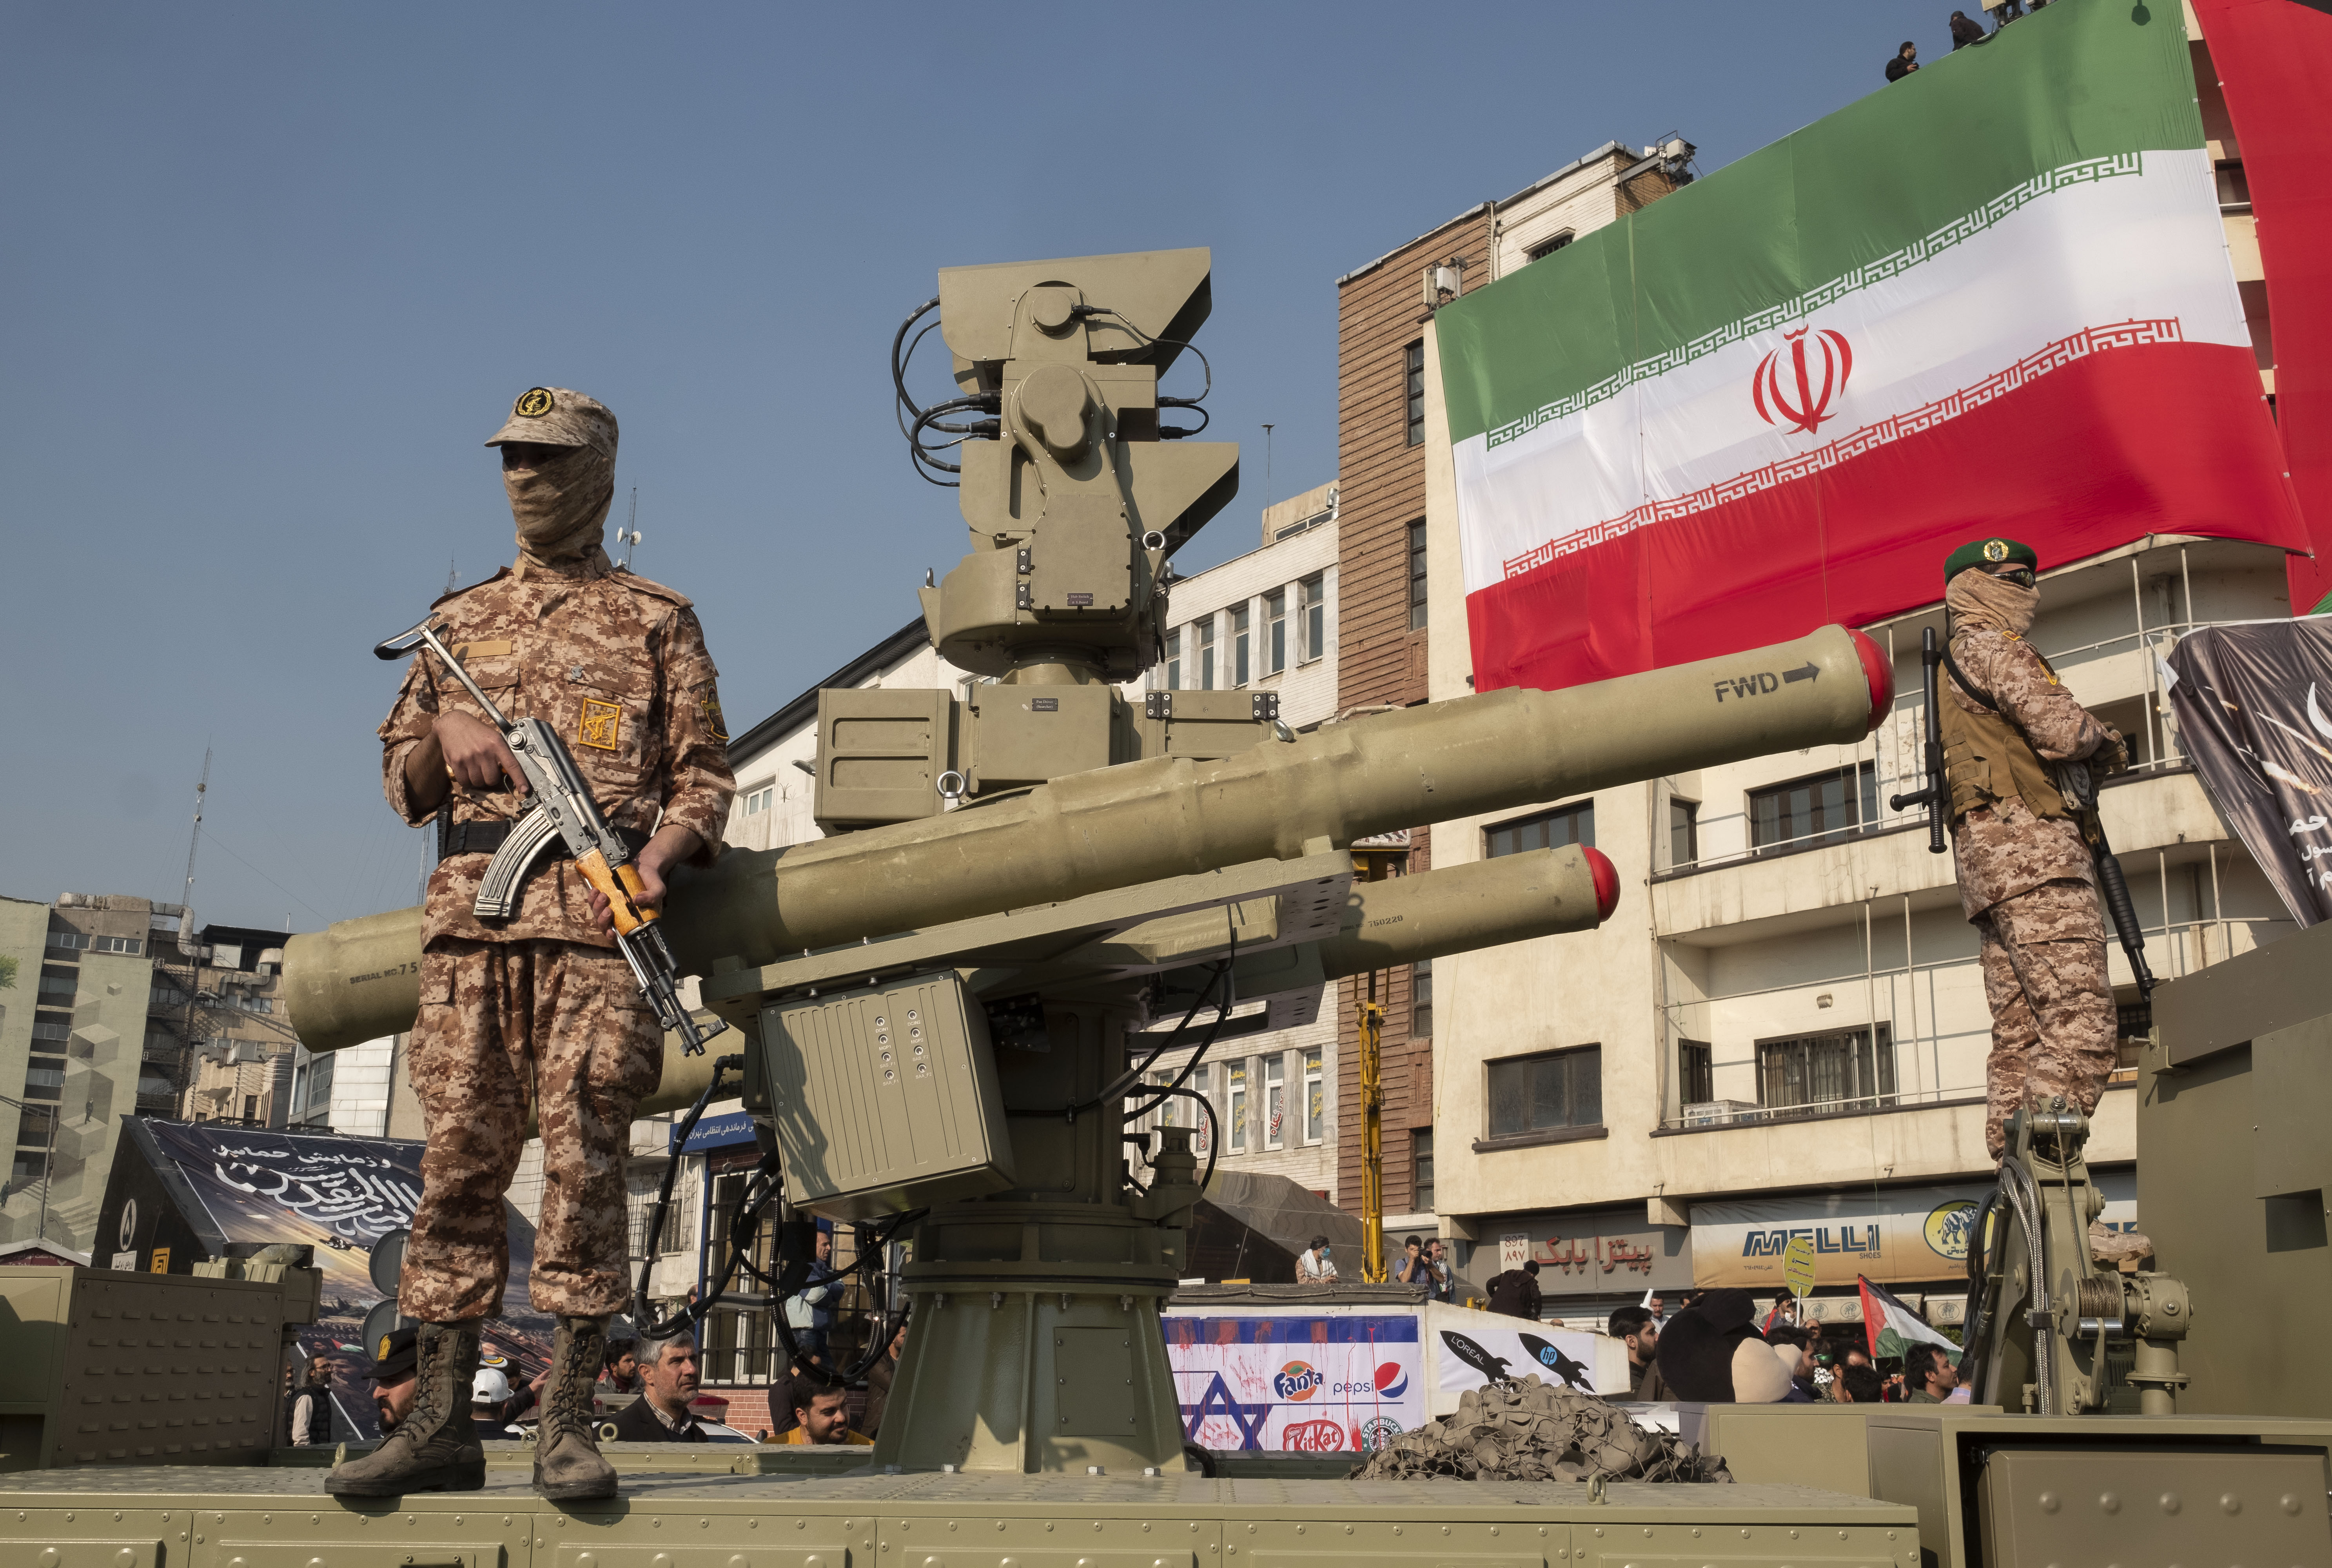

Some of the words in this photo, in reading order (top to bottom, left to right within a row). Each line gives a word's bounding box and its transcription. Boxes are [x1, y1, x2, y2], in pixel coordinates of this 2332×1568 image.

[1713, 672, 1778, 702] FWD
[350, 972, 382, 984] SERIAL
[702, 1125, 721, 1139] انتظامی
[721, 1121, 746, 1136] فرماندهی
[1505, 1235, 1524, 1247] 897
[1535, 1236, 1586, 1272] بابک
[1596, 1236, 1651, 1272] پیتزا
[1451, 1336, 1484, 1365] L'ORÉAL
[1543, 1347, 1555, 1365] hp
[1274, 1368, 1324, 1399] Fanta
[1334, 1380, 1374, 1395] pepsi
[1293, 1424, 1338, 1451] KitKat
